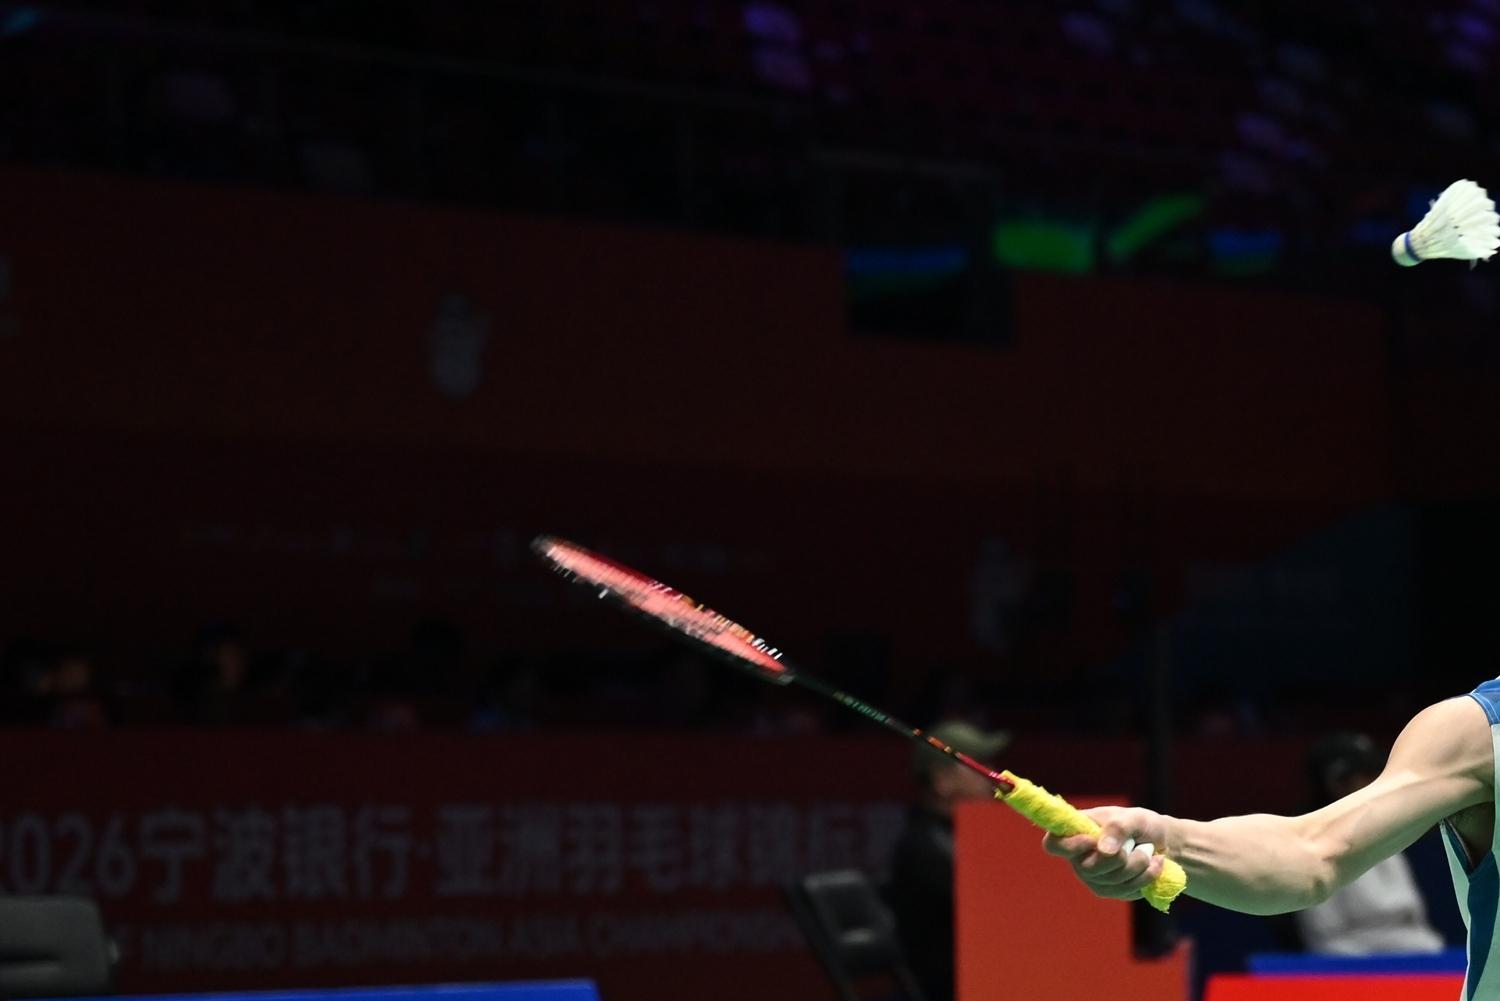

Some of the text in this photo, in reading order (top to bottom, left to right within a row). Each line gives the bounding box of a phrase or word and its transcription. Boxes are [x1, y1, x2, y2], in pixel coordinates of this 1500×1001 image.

[0, 800, 906, 903] 026宁波银行·亚洲羽毛球锦标赛
